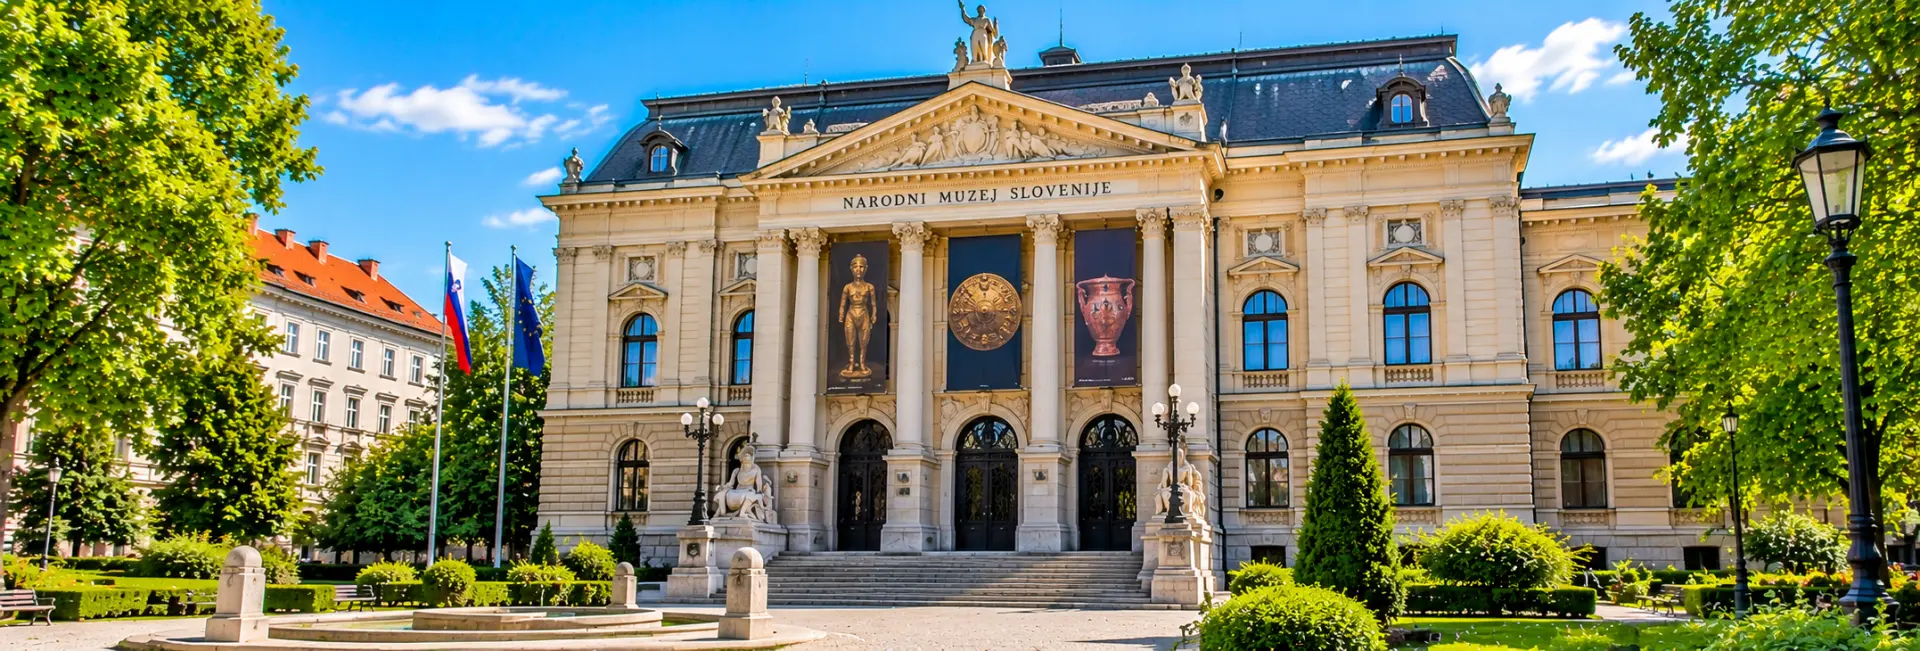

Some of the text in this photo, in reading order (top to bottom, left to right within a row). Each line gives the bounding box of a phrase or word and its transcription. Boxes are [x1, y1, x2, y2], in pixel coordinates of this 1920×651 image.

[843, 181, 1112, 209] NARODNI MUZEJ SLOVENIJE
